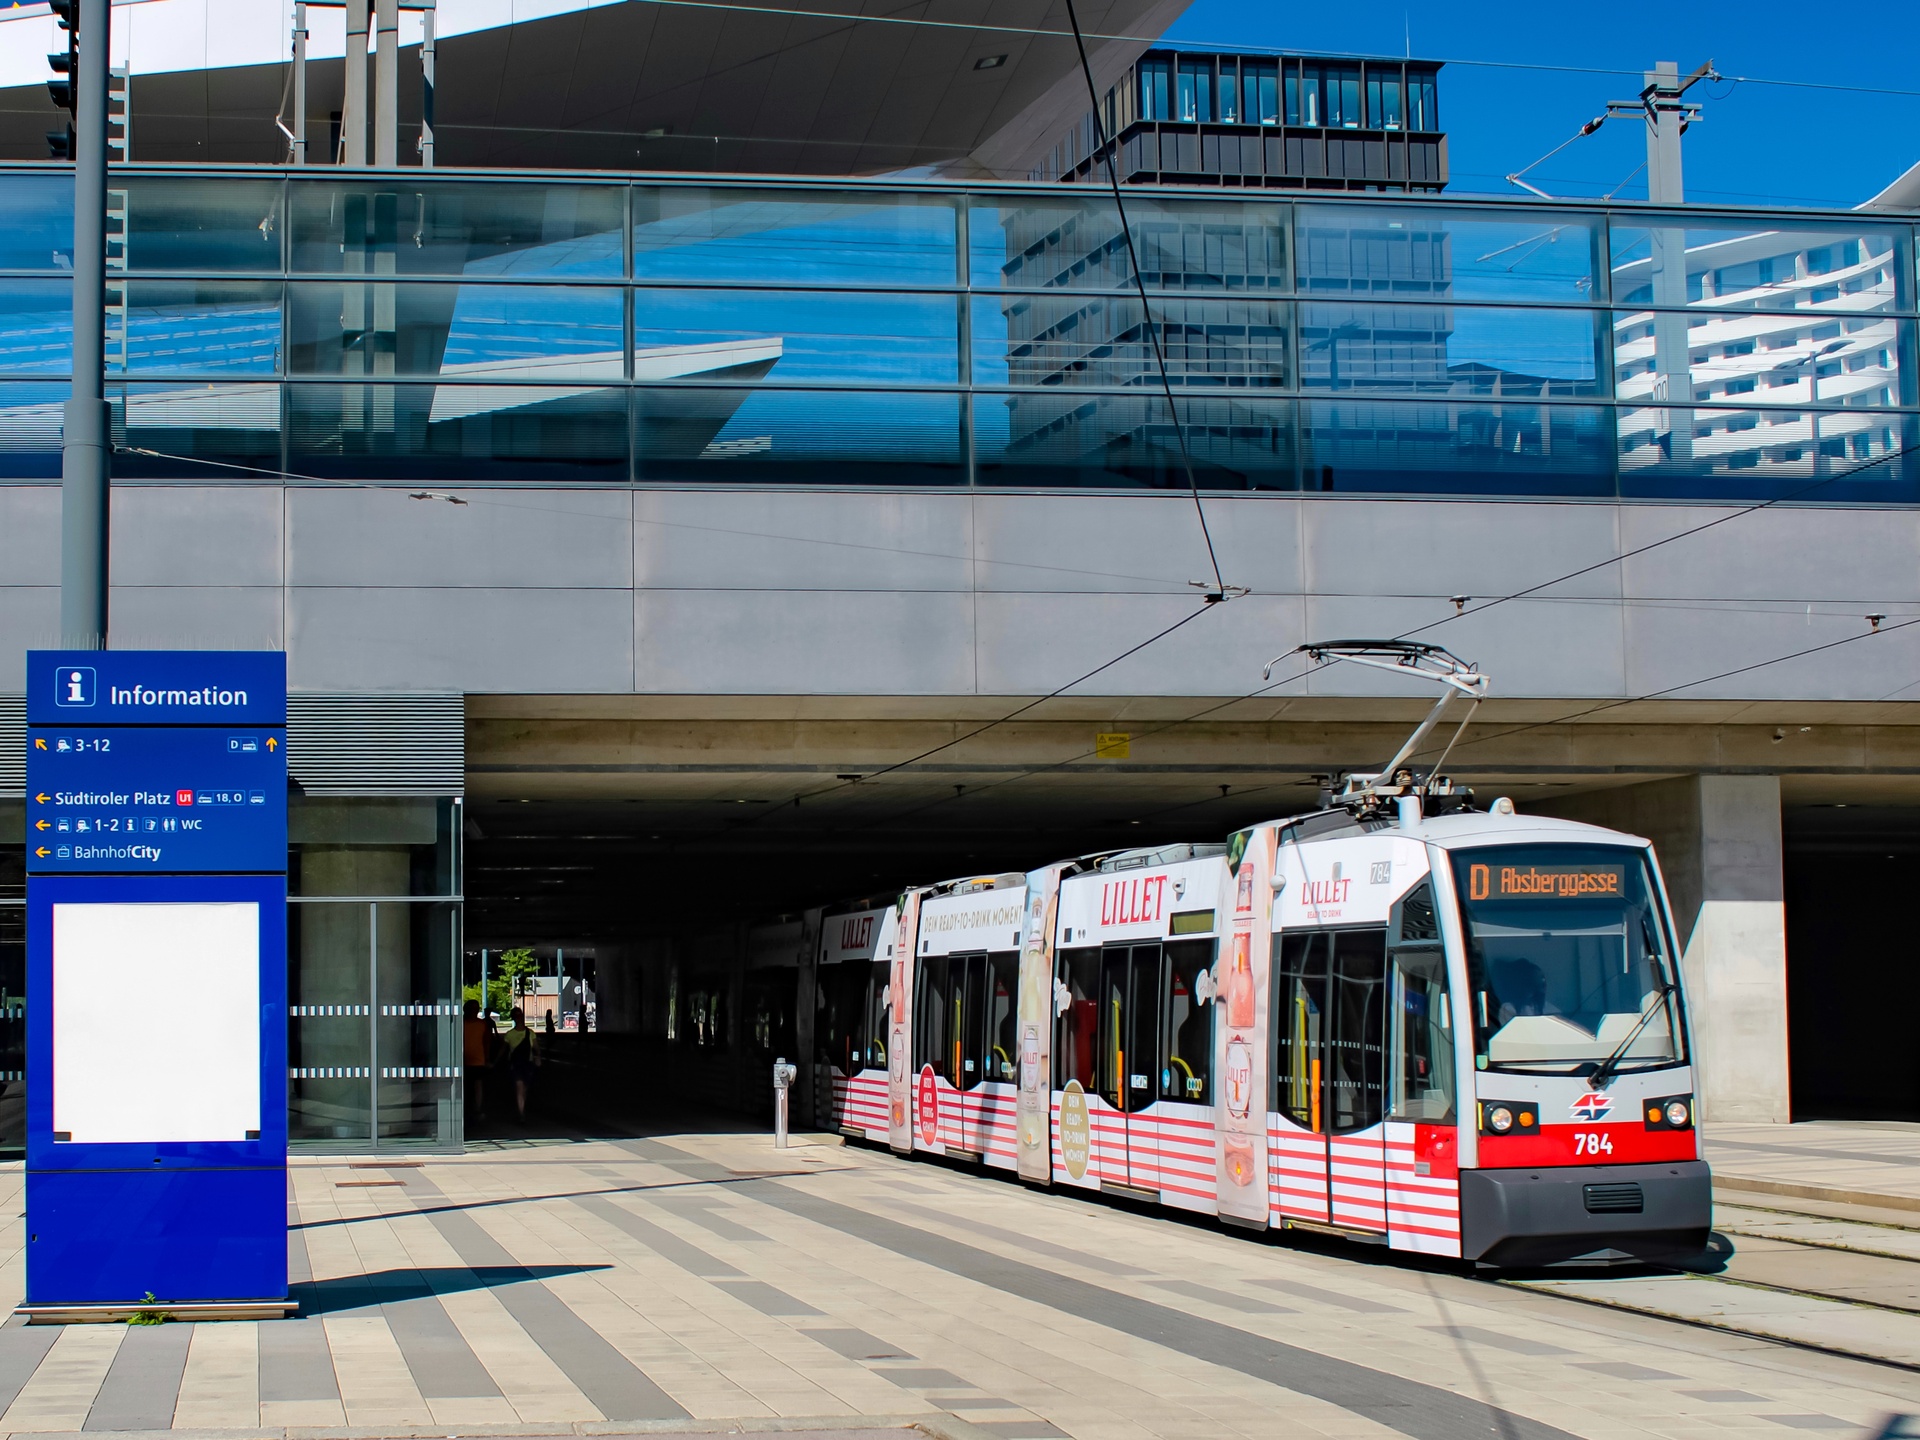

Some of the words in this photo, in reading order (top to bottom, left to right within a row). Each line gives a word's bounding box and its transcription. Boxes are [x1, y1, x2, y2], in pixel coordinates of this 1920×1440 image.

[110, 685, 248, 706] Information
[75, 738, 111, 752] 3-12
[230, 740, 239, 749] D
[55, 792, 129, 805] Südtiroler
[134, 792, 171, 805] Platz
[179, 794, 192, 803] U1
[216, 793, 231, 804] 18,
[94, 819, 119, 832] 1-2
[181, 819, 202, 830] WC
[74, 846, 161, 862] BahnhofCity
[1371, 863, 1389, 882] 784
[1470, 864, 1490, 900] D
[1501, 867, 1618, 897] Absberggasse
[1101, 875, 1167, 926] LILLET
[1302, 879, 1351, 905] LILLET
[924, 915, 938, 933] DEIN
[992, 905, 1022, 925] MOMENT
[841, 916, 874, 949] LILLET
[1574, 1133, 1613, 1155] 784
[1065, 1149, 1086, 1163] MOMENT
